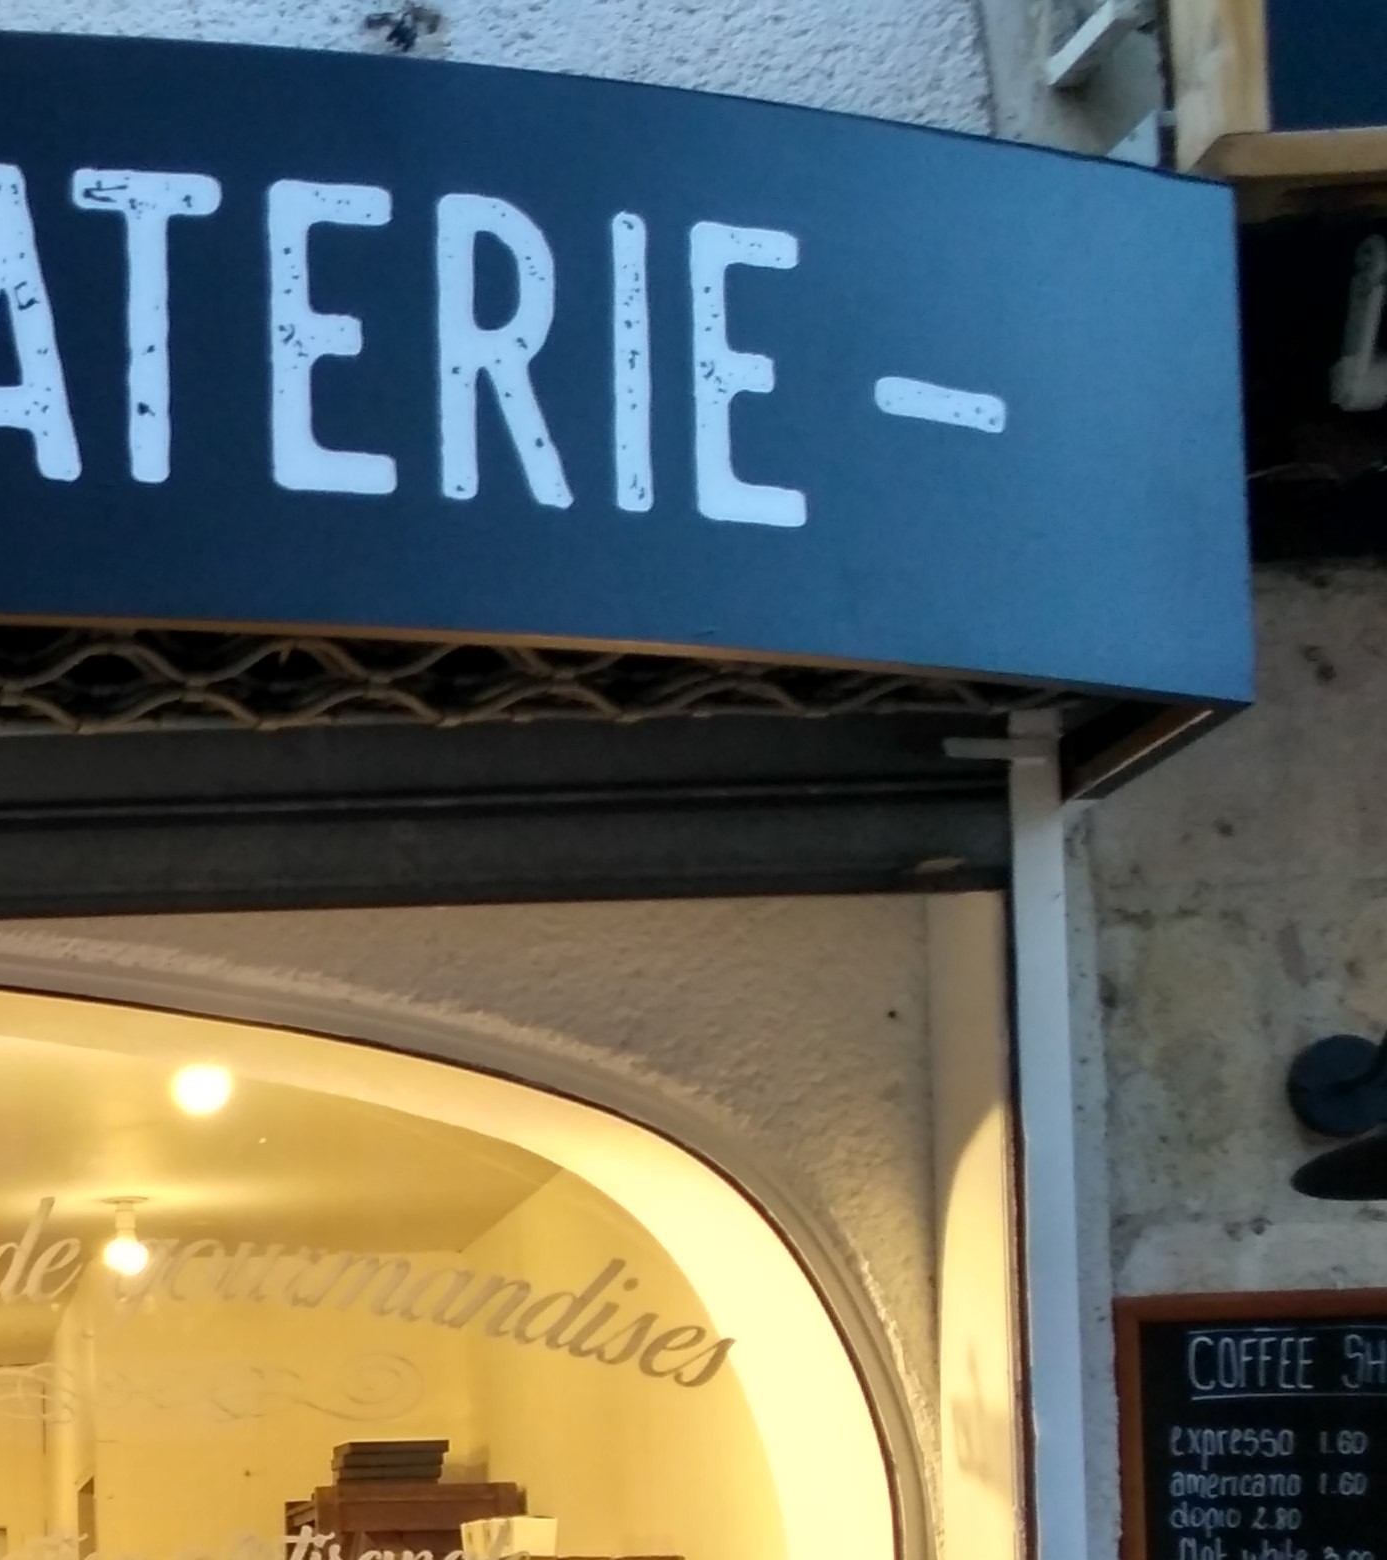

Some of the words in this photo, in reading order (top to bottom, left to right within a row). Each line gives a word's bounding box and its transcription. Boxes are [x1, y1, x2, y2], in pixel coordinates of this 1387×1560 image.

[106, 1248, 741, 1393] gourmandises
[1188, 1335, 1317, 1391] COFFEE
[1170, 1426, 1295, 1471] expresso
[1319, 1429, 1369, 1455] 1.60
[1170, 1471, 1302, 1499] americano
[1319, 1471, 1369, 1496] 1.60
[1169, 1502, 1242, 1538] dopio
[1251, 1506, 1302, 1530] 2.80
